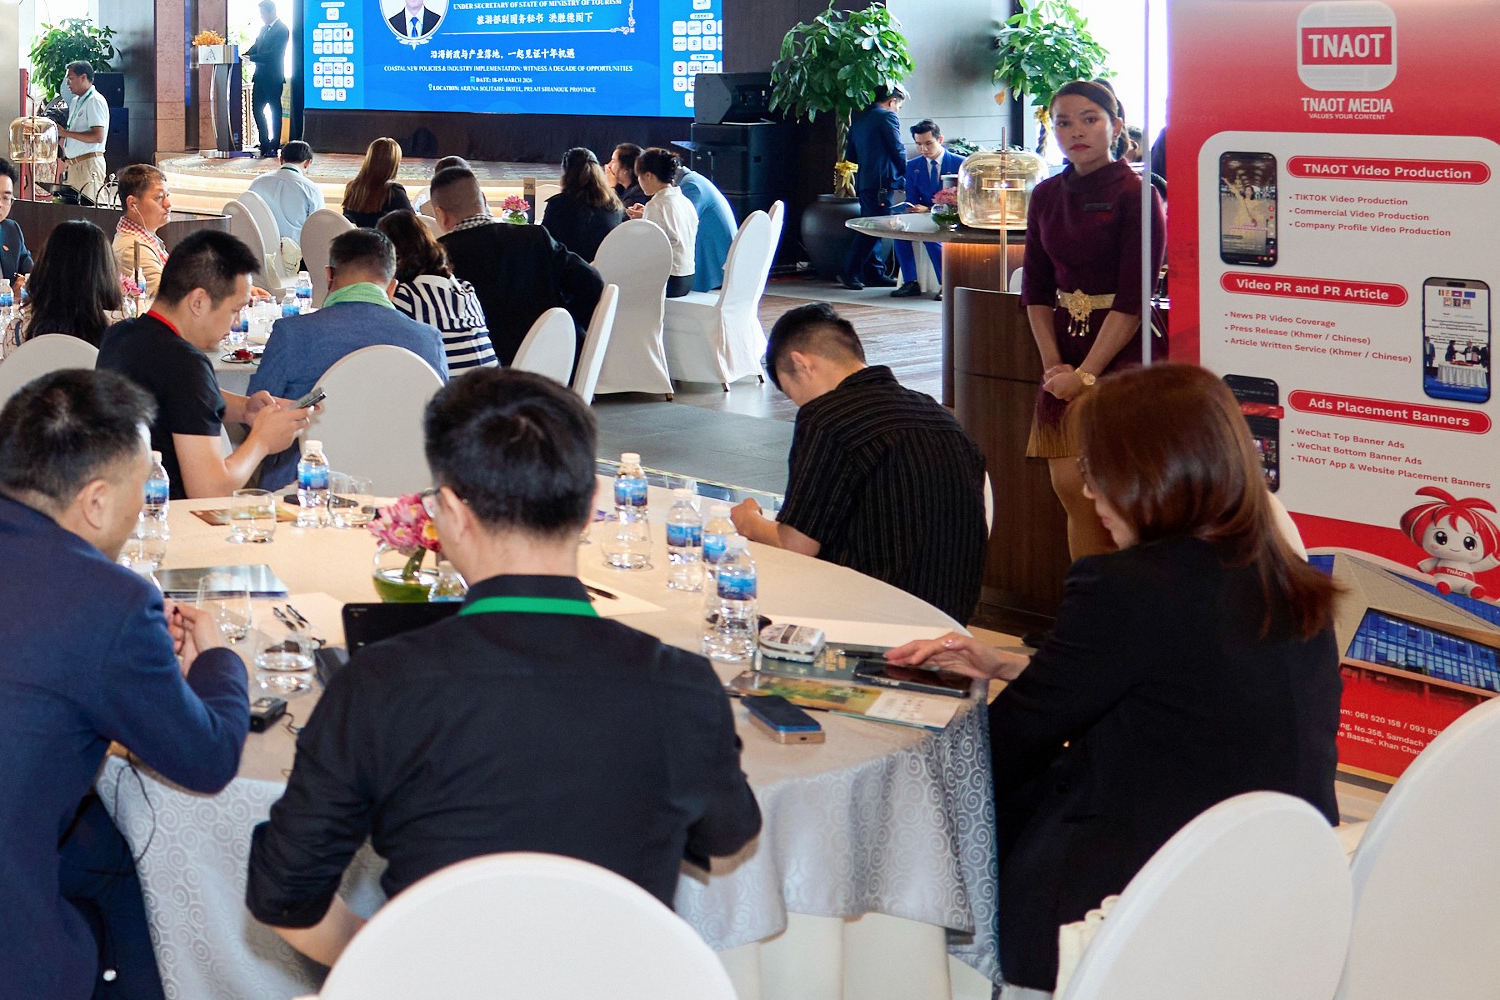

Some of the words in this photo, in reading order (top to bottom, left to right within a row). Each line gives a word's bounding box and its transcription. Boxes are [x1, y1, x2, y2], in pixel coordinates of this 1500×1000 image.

[548, 0, 579, 7] MINISTRY
[1308, 34, 1385, 58] TNAOT
[1301, 97, 1345, 112] TNAOT
[1348, 98, 1394, 113] MEDIA
[1303, 163, 1348, 175] TNAOT
[1351, 164, 1390, 177] Video
[1394, 165, 1471, 180] Production
[1294, 193, 1328, 203] TIKTOK
[1329, 194, 1355, 204] Video
[1357, 196, 1408, 206] Production
[1294, 207, 1348, 217] Commercial
[1350, 209, 1375, 219] Video
[1377, 211, 1430, 222] Production
[1294, 221, 1335, 232] Company
[1337, 222, 1368, 232] Profile
[1370, 224, 1396, 233] Video
[1398, 225, 1451, 237] Production
[1236, 277, 1272, 291] Video
[1274, 280, 1292, 292] PR
[1295, 281, 1320, 295] and
[1323, 285, 1341, 297] PR
[1344, 285, 1389, 300] Article
[1230, 311, 1254, 320] News
[1255, 313, 1267, 321] PR
[1268, 314, 1294, 324] Video
[1295, 316, 1336, 329] Coverage
[1230, 323, 1253, 334] Press
[1254, 325, 1288, 337] Release
[1290, 328, 1323, 341] (Khmer
[1331, 332, 1371, 345] Chinese)
[1230, 337, 1258, 347] Article
[1260, 339, 1292, 351] Written
[1293, 342, 1327, 354] Service
[1329, 346, 1362, 359] (Khmer
[1371, 350, 1413, 364] Chinese)
[1308, 397, 1333, 410] Ads
[1336, 401, 1409, 420] Placement
[1412, 411, 1470, 427] Banners
[1297, 428, 1331, 440] WeChat
[1333, 432, 1350, 443] Top
[1352, 434, 1385, 447] Banner
[1387, 439, 1405, 449] Ads
[1297, 441, 1331, 453] WeChat
[1333, 446, 1367, 458] Bottom
[1369, 451, 1402, 463] Banner
[1404, 455, 1423, 466] Ads
[1297, 455, 1326, 466] TNAOT
[1328, 459, 1347, 470] App
[1357, 463, 1396, 476] Website
[1397, 469, 1449, 484] Placement
[1451, 477, 1491, 490] Banners
[1355, 711, 1369, 720] 061
[1371, 714, 1386, 724] 520
[1387, 718, 1402, 728] 158
[1409, 724, 1425, 734] 093
[1346, 732, 1377, 746] Bassac,
[1378, 740, 1399, 751] Khan
[1386, 732, 1424, 748] Samdach
